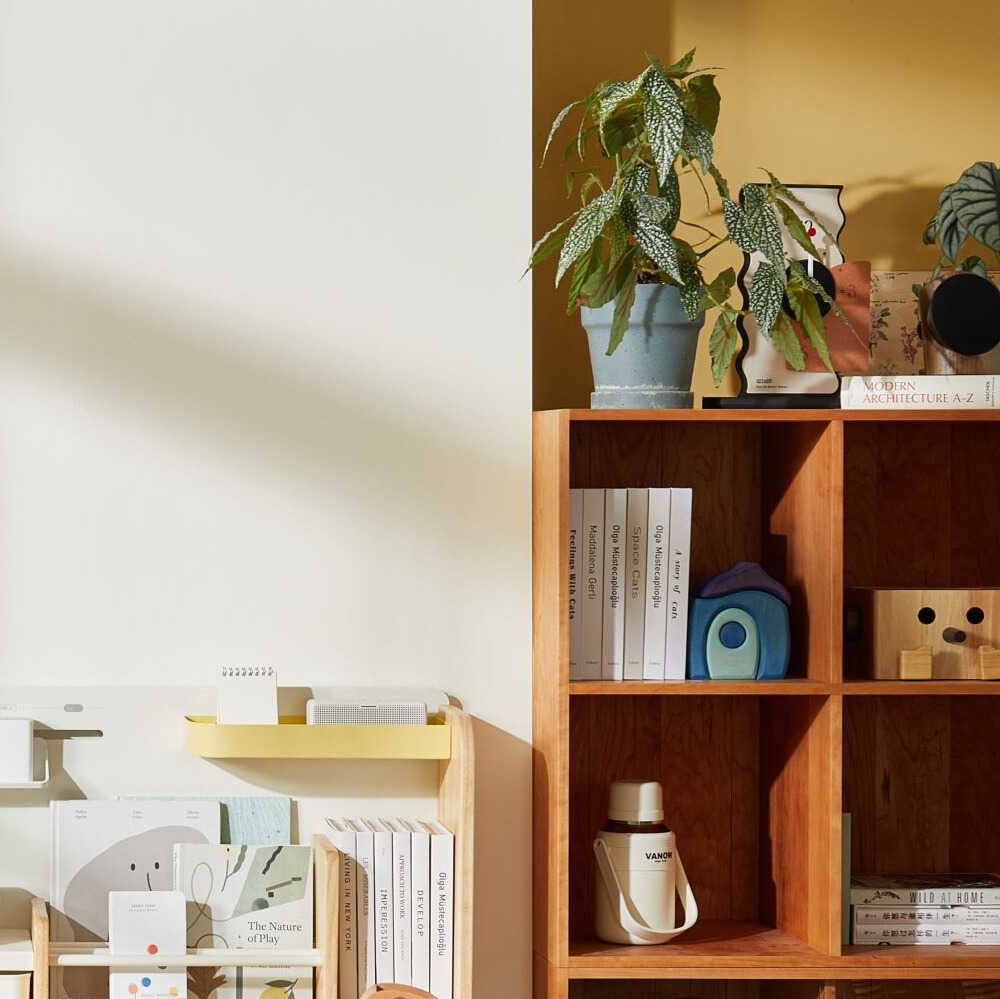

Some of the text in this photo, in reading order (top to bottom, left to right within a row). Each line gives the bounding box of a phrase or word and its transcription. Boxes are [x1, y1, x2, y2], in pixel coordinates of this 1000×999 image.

[864, 381, 916, 391] MODERN
[863, 393, 948, 404] ARCHITECTURE
[611, 524, 620, 544] Olga
[654, 524, 664, 544] Olga
[569, 529, 577, 570] Feelings
[588, 525, 597, 600] Maddalena Gerli
[631, 526, 642, 599] Space Cats
[673, 584, 681, 594] of
[568, 598, 576, 620] Cats
[437, 872, 447, 891] Olga
[344, 888, 351, 898] IN
[909, 891, 984, 904] WILD AT HOME
[344, 902, 352, 922] NEW
[247, 921, 302, 931] The Nature
[247, 933, 280, 946] of Play
